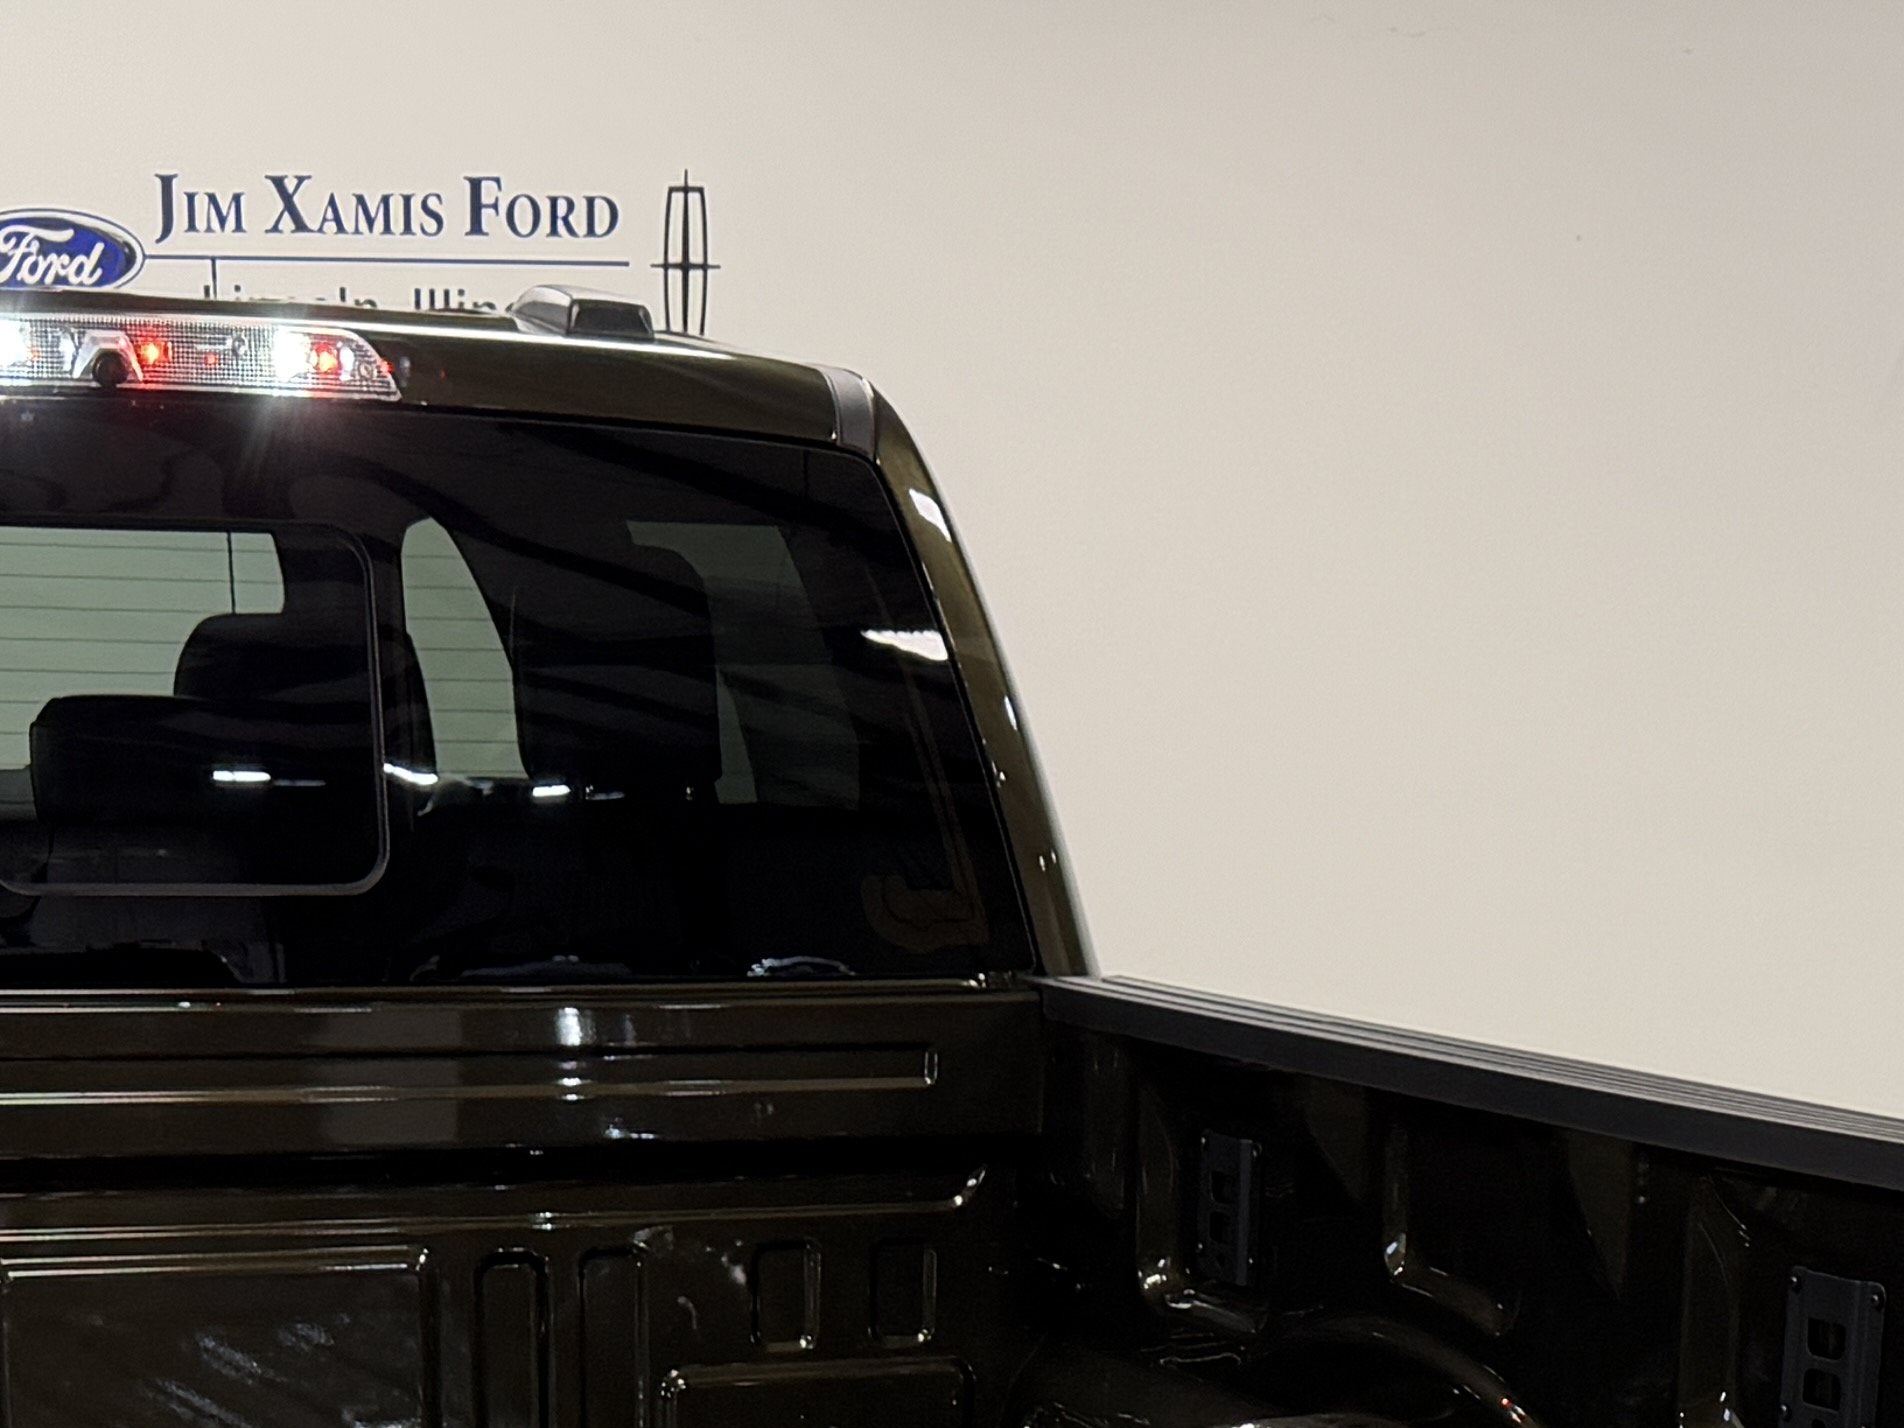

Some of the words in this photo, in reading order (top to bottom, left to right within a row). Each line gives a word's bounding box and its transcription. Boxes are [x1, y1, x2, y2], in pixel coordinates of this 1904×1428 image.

[154, 173, 247, 245] JIM
[264, 174, 444, 238] XAMIS
[463, 175, 619, 239] FORD
